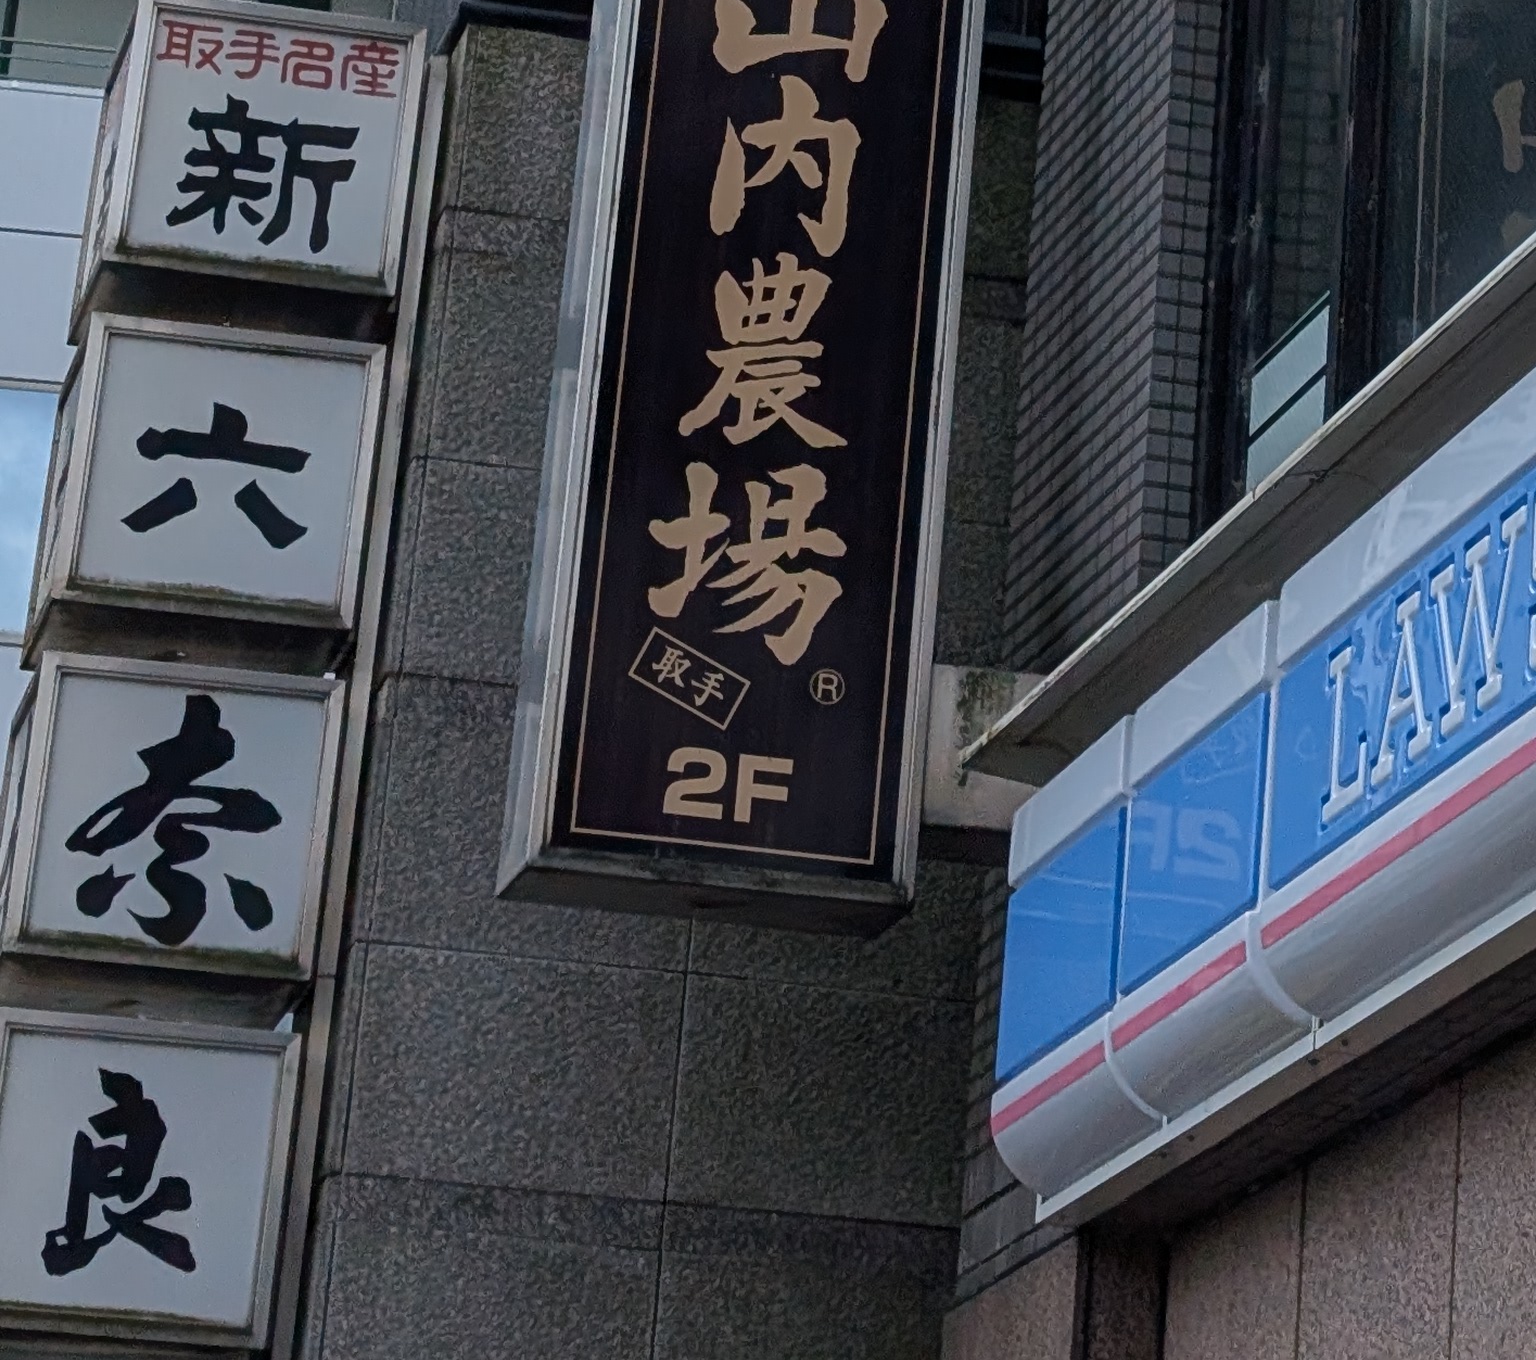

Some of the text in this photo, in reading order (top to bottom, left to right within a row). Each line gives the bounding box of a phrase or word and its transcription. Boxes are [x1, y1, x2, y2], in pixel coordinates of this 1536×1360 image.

[157, 20, 401, 99] 取手名産
[652, 645, 726, 707] 取手
[662, 746, 794, 824] 2F
